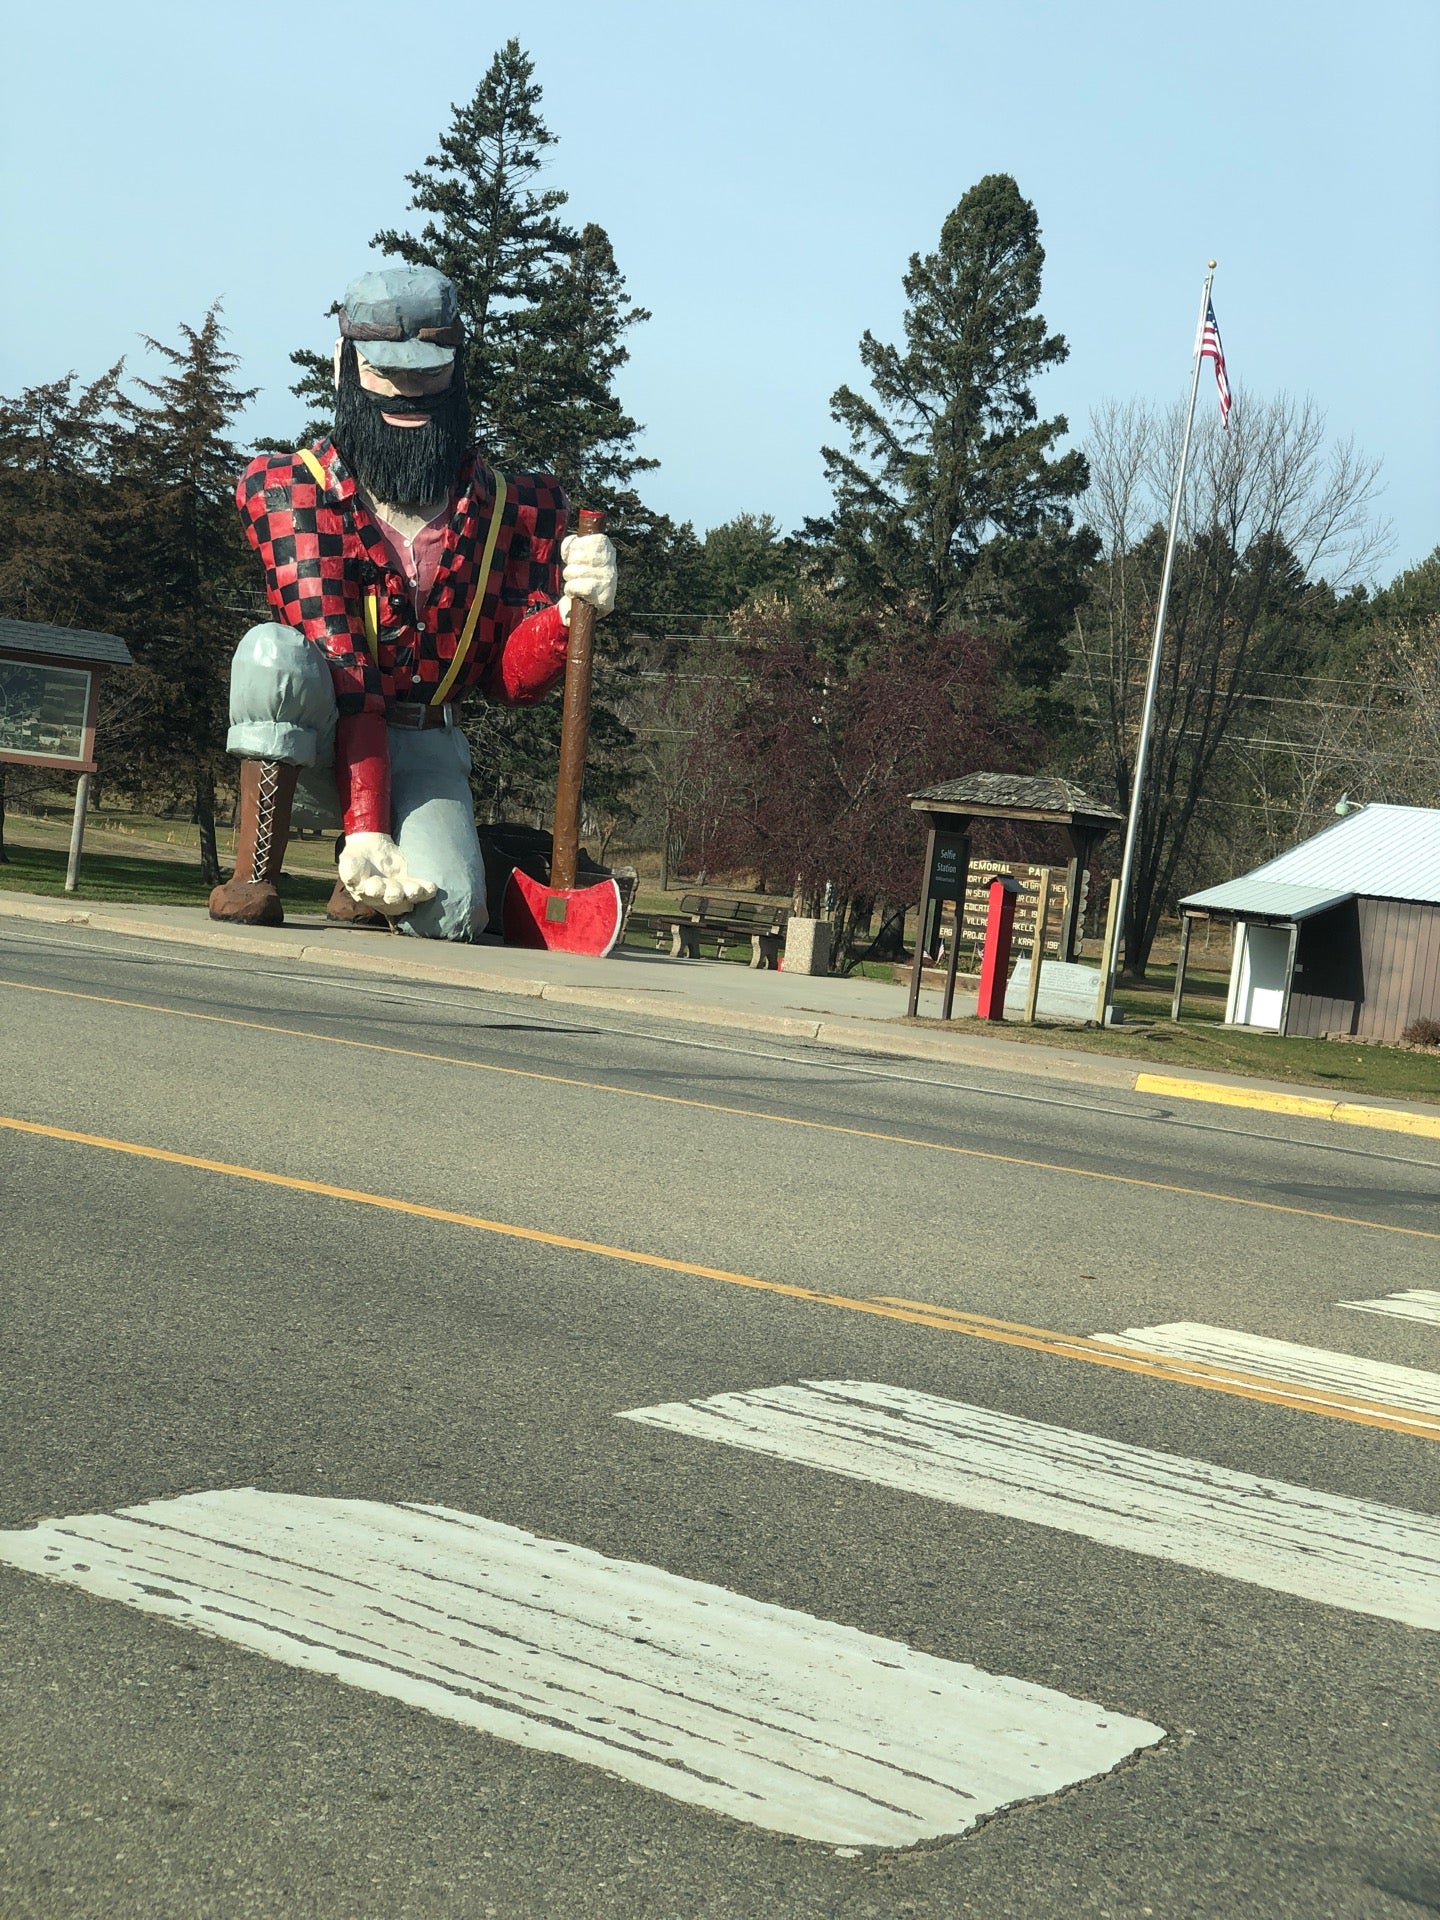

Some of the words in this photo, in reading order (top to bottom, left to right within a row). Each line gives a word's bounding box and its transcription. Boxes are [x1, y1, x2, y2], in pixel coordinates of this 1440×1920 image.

[940, 849, 956, 860] Selfie
[936, 862, 957, 873] Station
[973, 890, 990, 898] SERV
[962, 930, 987, 940] PROJEC
